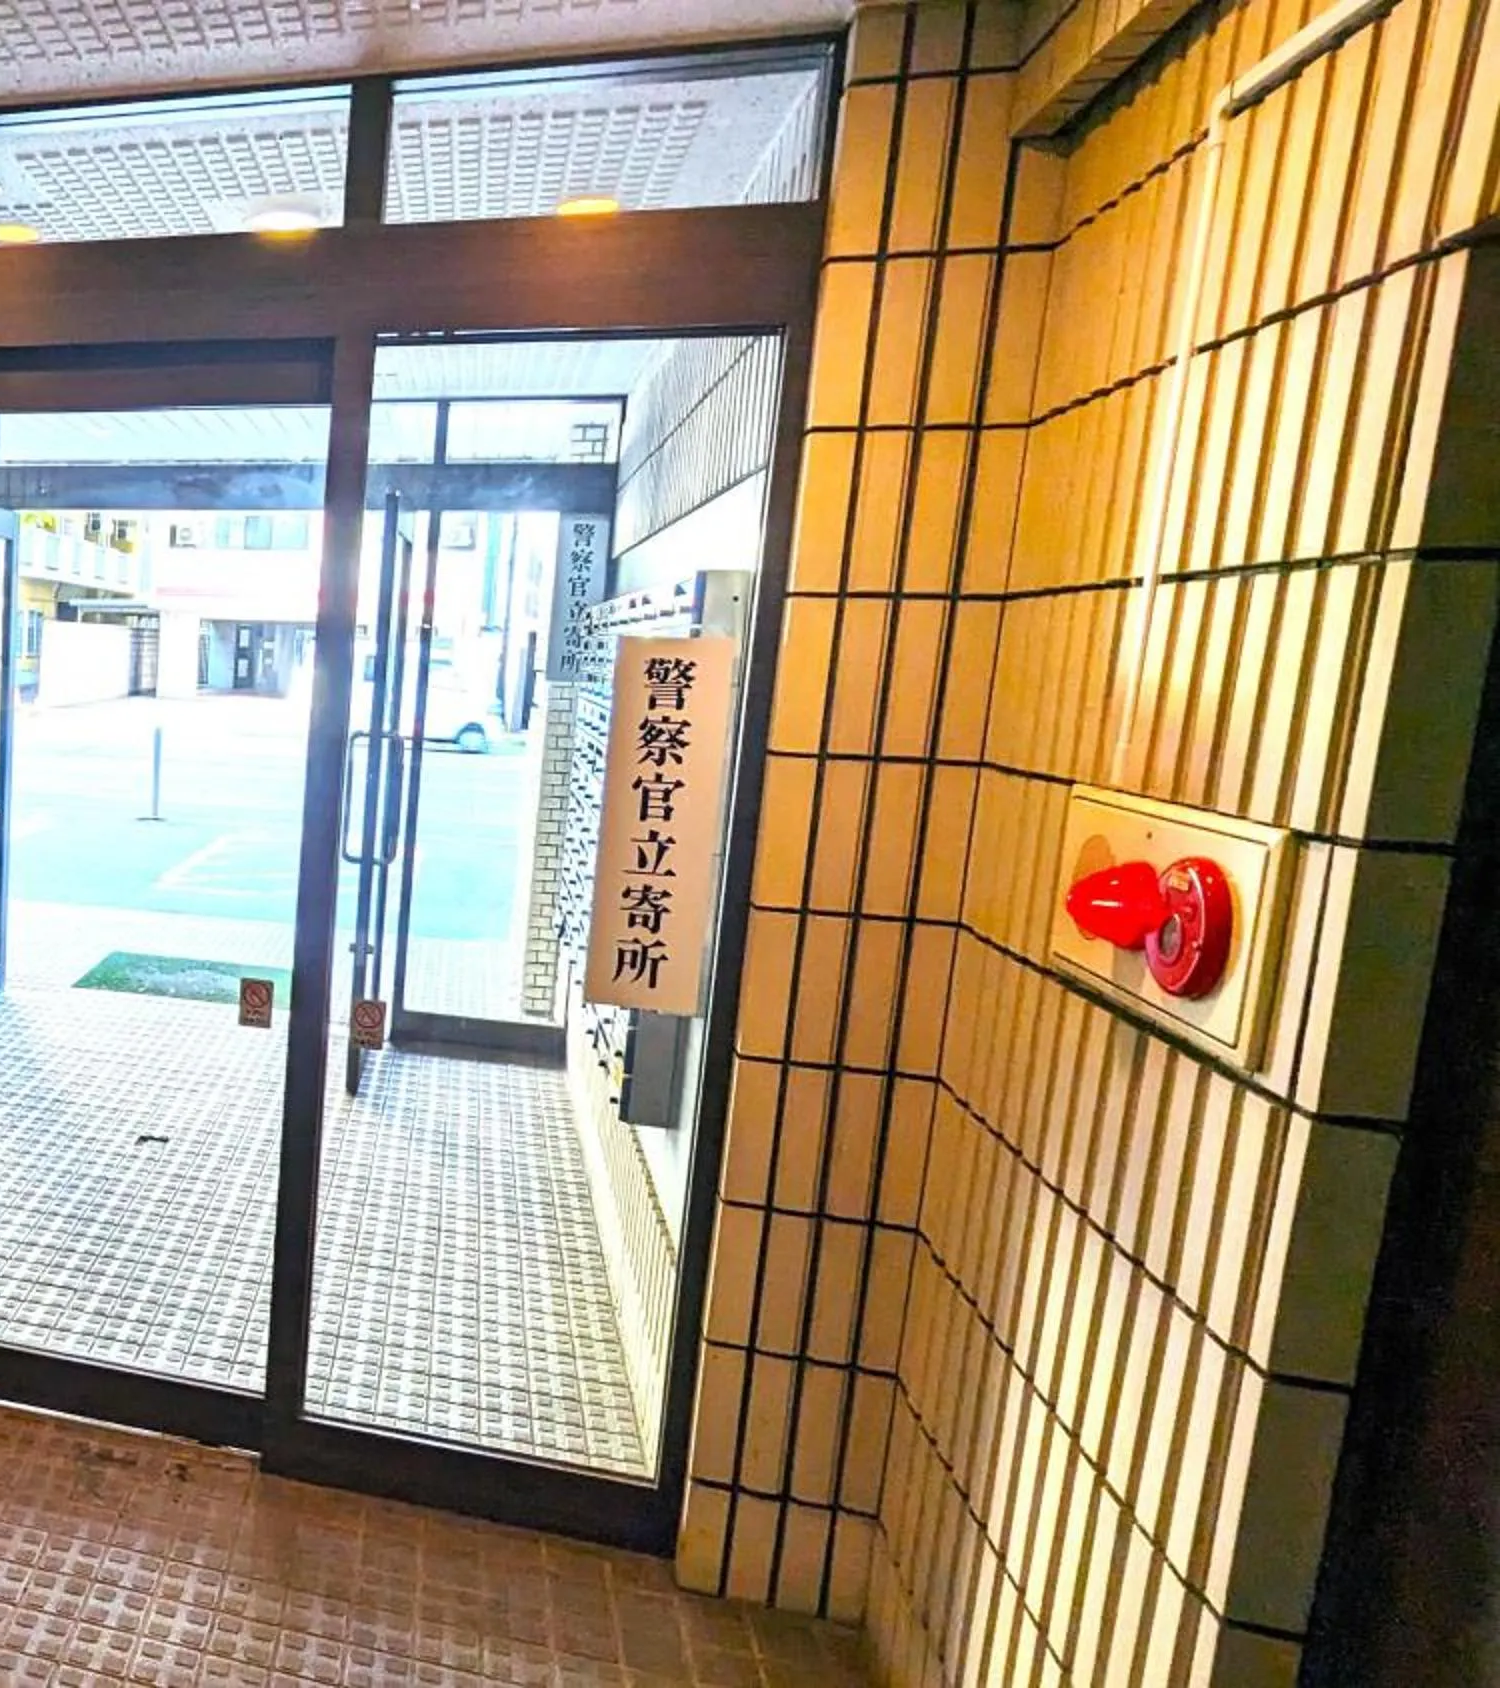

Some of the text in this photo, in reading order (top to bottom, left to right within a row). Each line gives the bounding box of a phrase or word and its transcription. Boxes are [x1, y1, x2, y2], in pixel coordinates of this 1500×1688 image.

[560, 523, 596, 674] 警察官立寄所
[612, 657, 697, 989] 警察官立寄所
